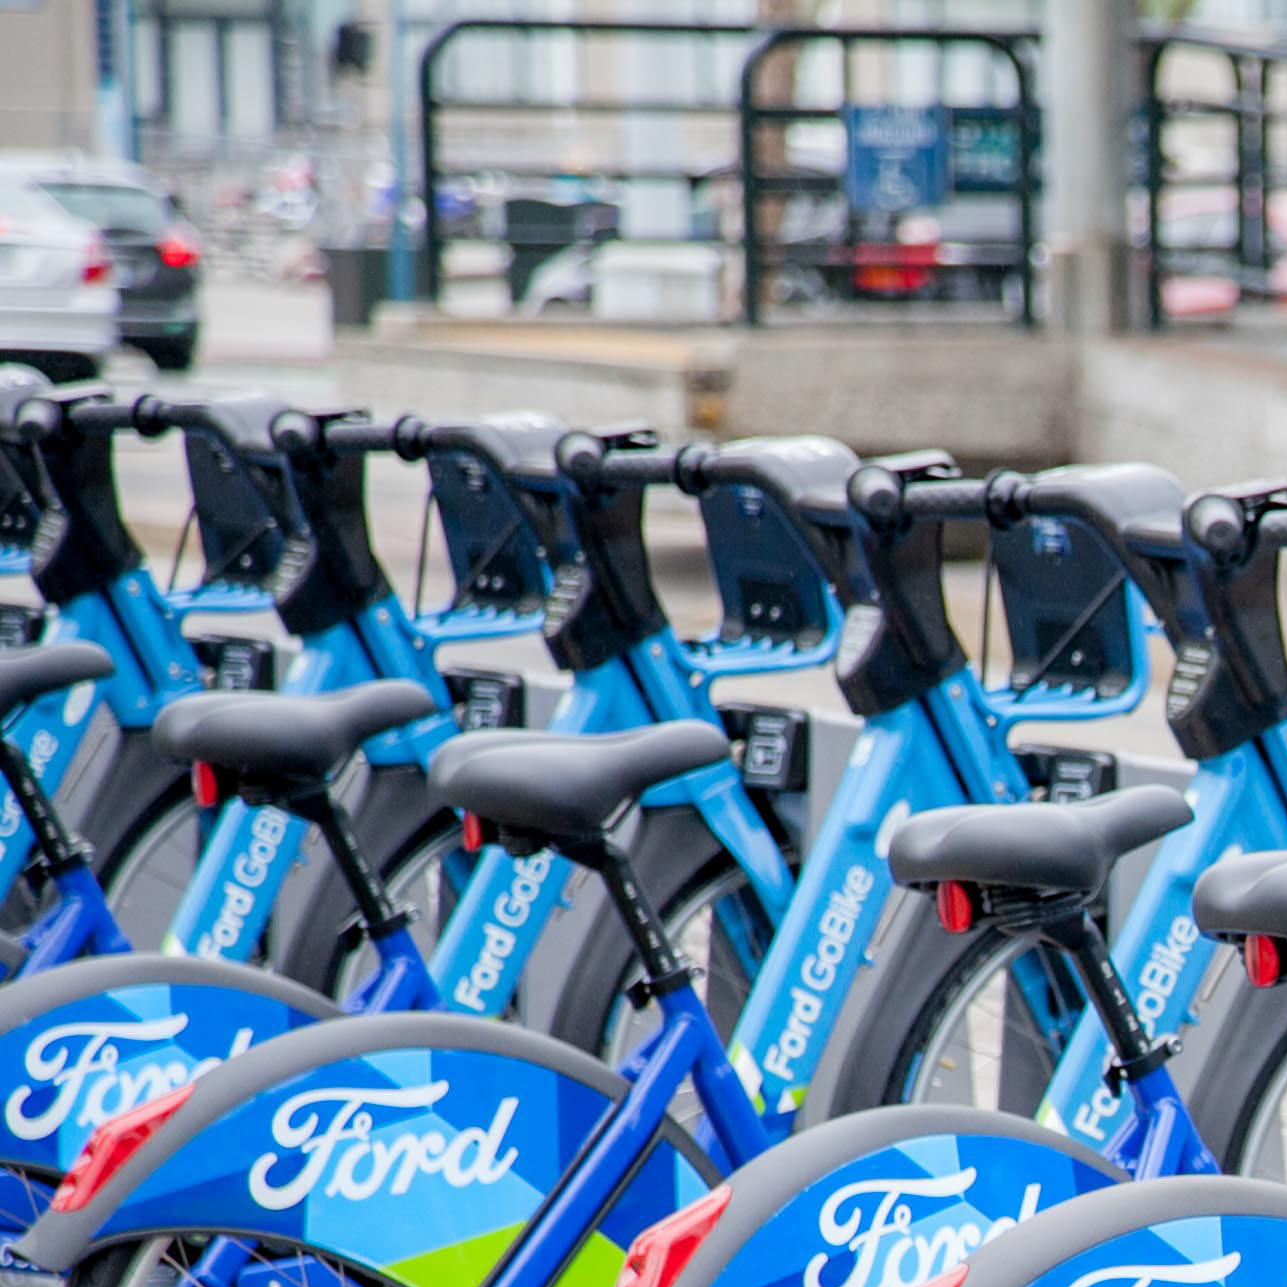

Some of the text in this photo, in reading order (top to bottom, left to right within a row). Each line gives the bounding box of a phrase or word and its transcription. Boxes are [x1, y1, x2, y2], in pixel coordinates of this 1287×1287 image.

[453, 921, 518, 1012] Ford
[763, 864, 875, 1082] Ford GoBike
[249, 1080, 519, 1210] Ford
